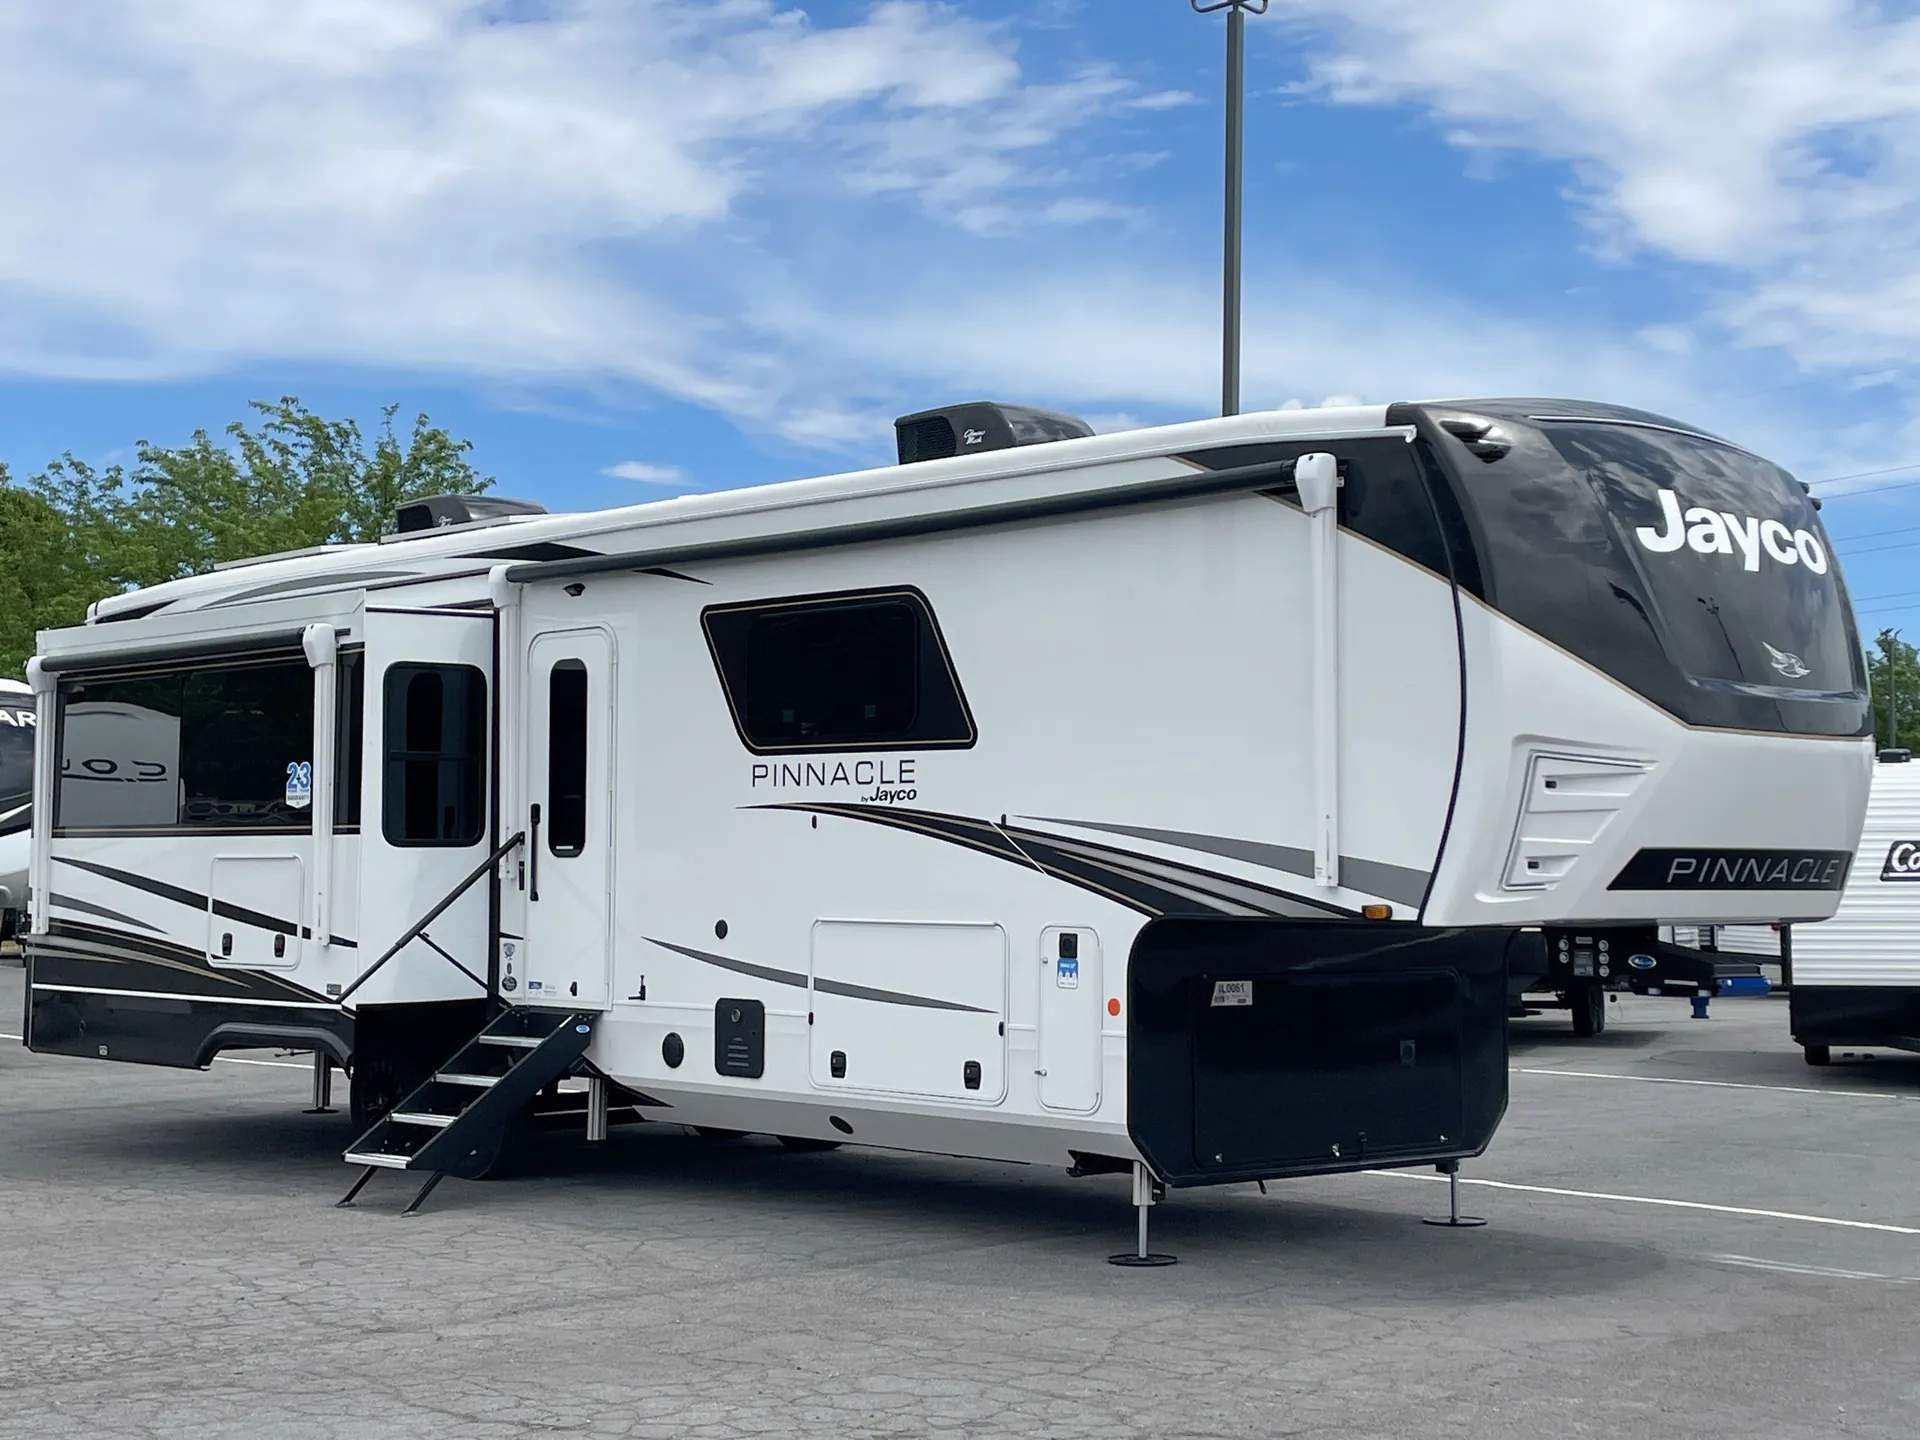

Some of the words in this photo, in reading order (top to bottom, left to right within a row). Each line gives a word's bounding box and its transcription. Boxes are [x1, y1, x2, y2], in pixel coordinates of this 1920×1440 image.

[1636, 488, 1828, 575] Jayco
[752, 759, 915, 788] PINNACLE
[860, 795, 869, 804] by
[870, 786, 917, 804] Jayco
[1666, 857, 1840, 883] PINNACLE
[1891, 843, 1920, 872] Co
